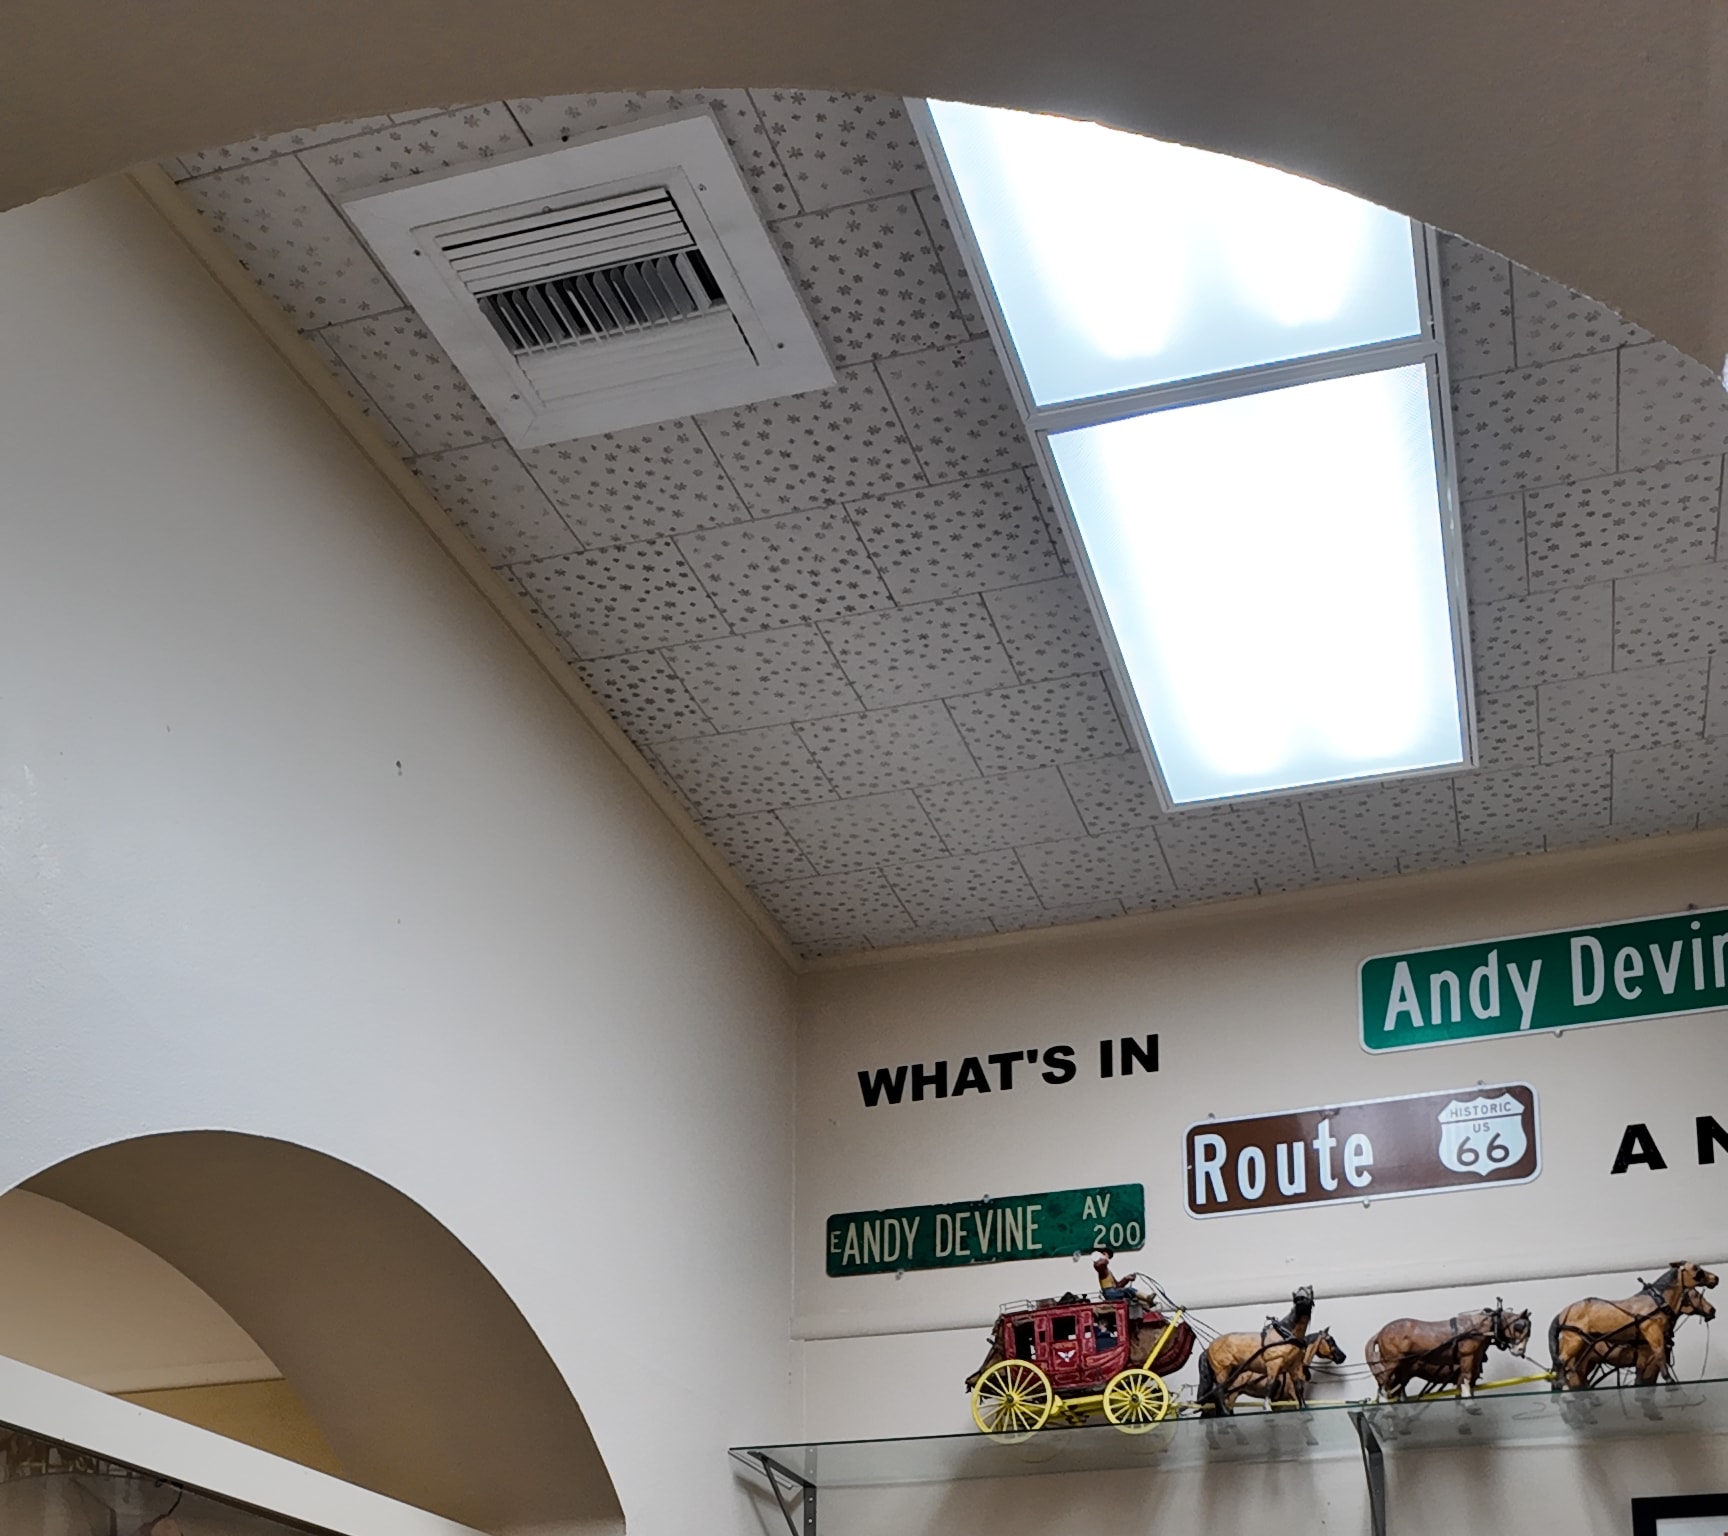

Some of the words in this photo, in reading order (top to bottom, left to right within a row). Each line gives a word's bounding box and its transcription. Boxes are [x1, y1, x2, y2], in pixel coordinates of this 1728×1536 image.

[1383, 949, 1542, 1031] Andy
[857, 1045, 1077, 1107] WHAT'S
[1099, 1034, 1160, 1079] IN
[1450, 1101, 1512, 1119] HISTORIC
[1473, 1122, 1490, 1133] US
[1193, 1118, 1374, 1205] Route
[1457, 1132, 1509, 1166] 66
[830, 1229, 841, 1254] E
[842, 1216, 920, 1265] ANDY
[935, 1204, 1043, 1257] DEVINE
[1082, 1193, 1112, 1220] AV
[1093, 1221, 1140, 1248] 200
